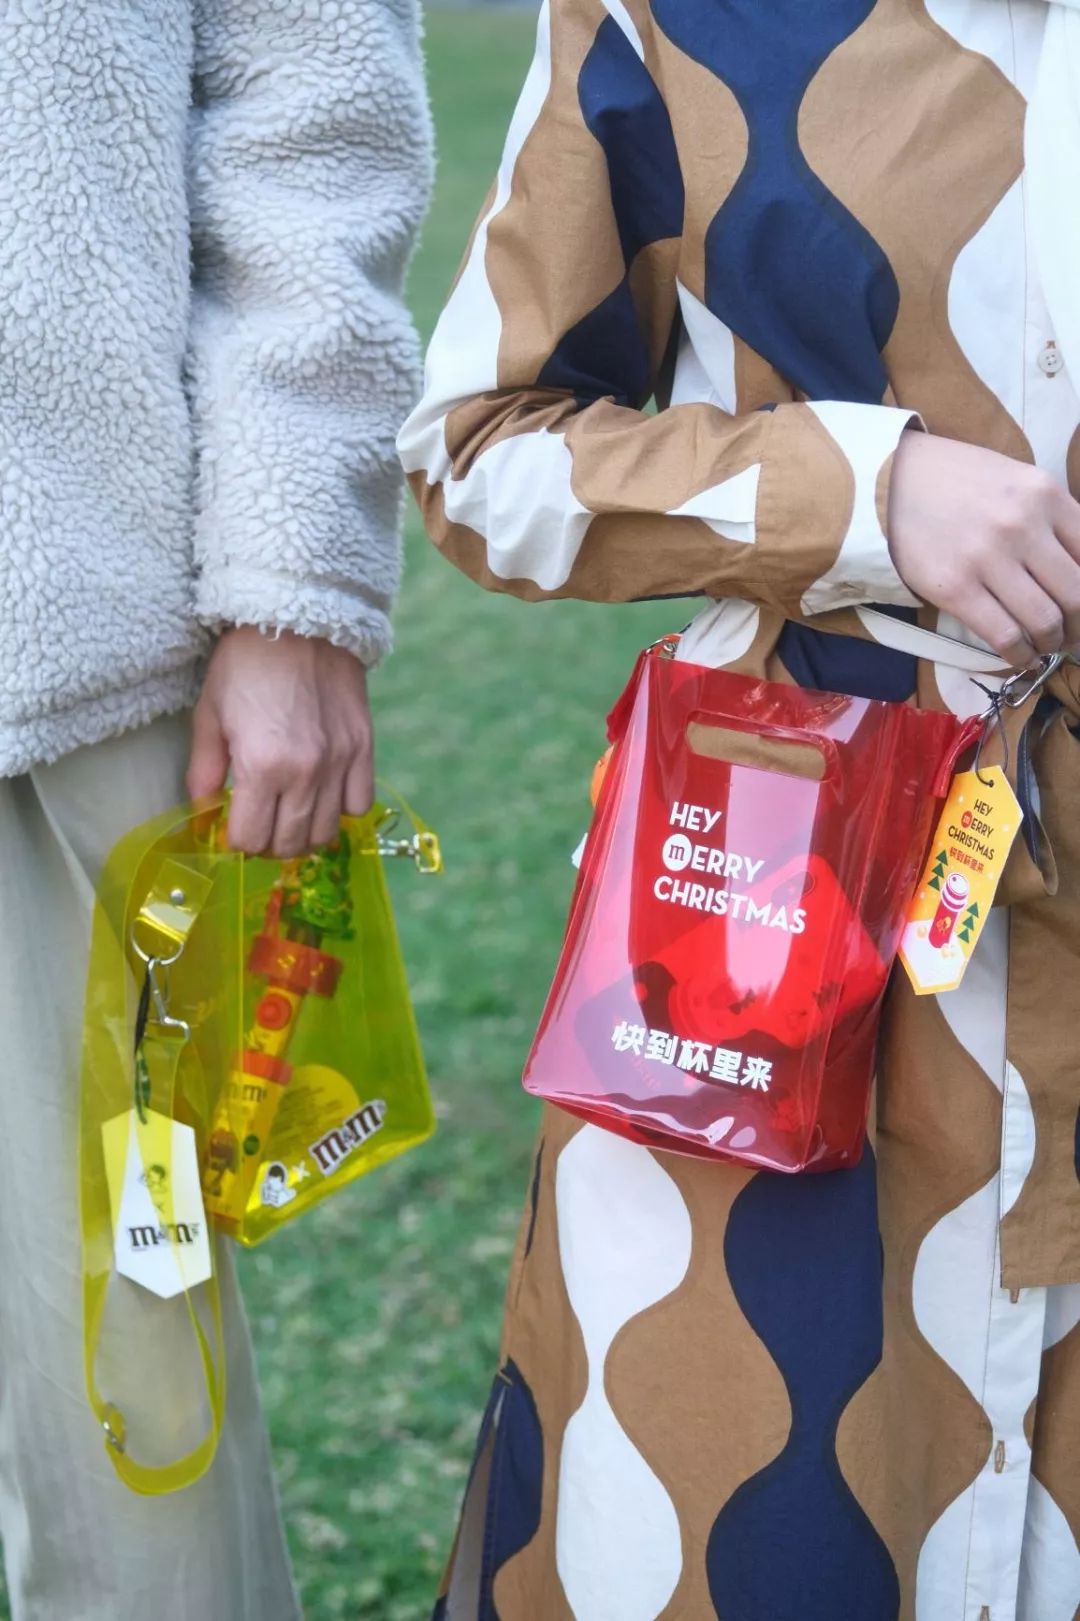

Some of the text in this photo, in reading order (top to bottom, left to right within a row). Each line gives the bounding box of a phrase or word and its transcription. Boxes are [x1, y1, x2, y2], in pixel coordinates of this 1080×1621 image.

[669, 801, 722, 832] HEY
[974, 799, 993, 816] HEY
[948, 825, 995, 860] CHRISTMAS
[653, 876, 807, 934] CHRISTMAS
[611, 1020, 773, 1093] 快到杯里来
